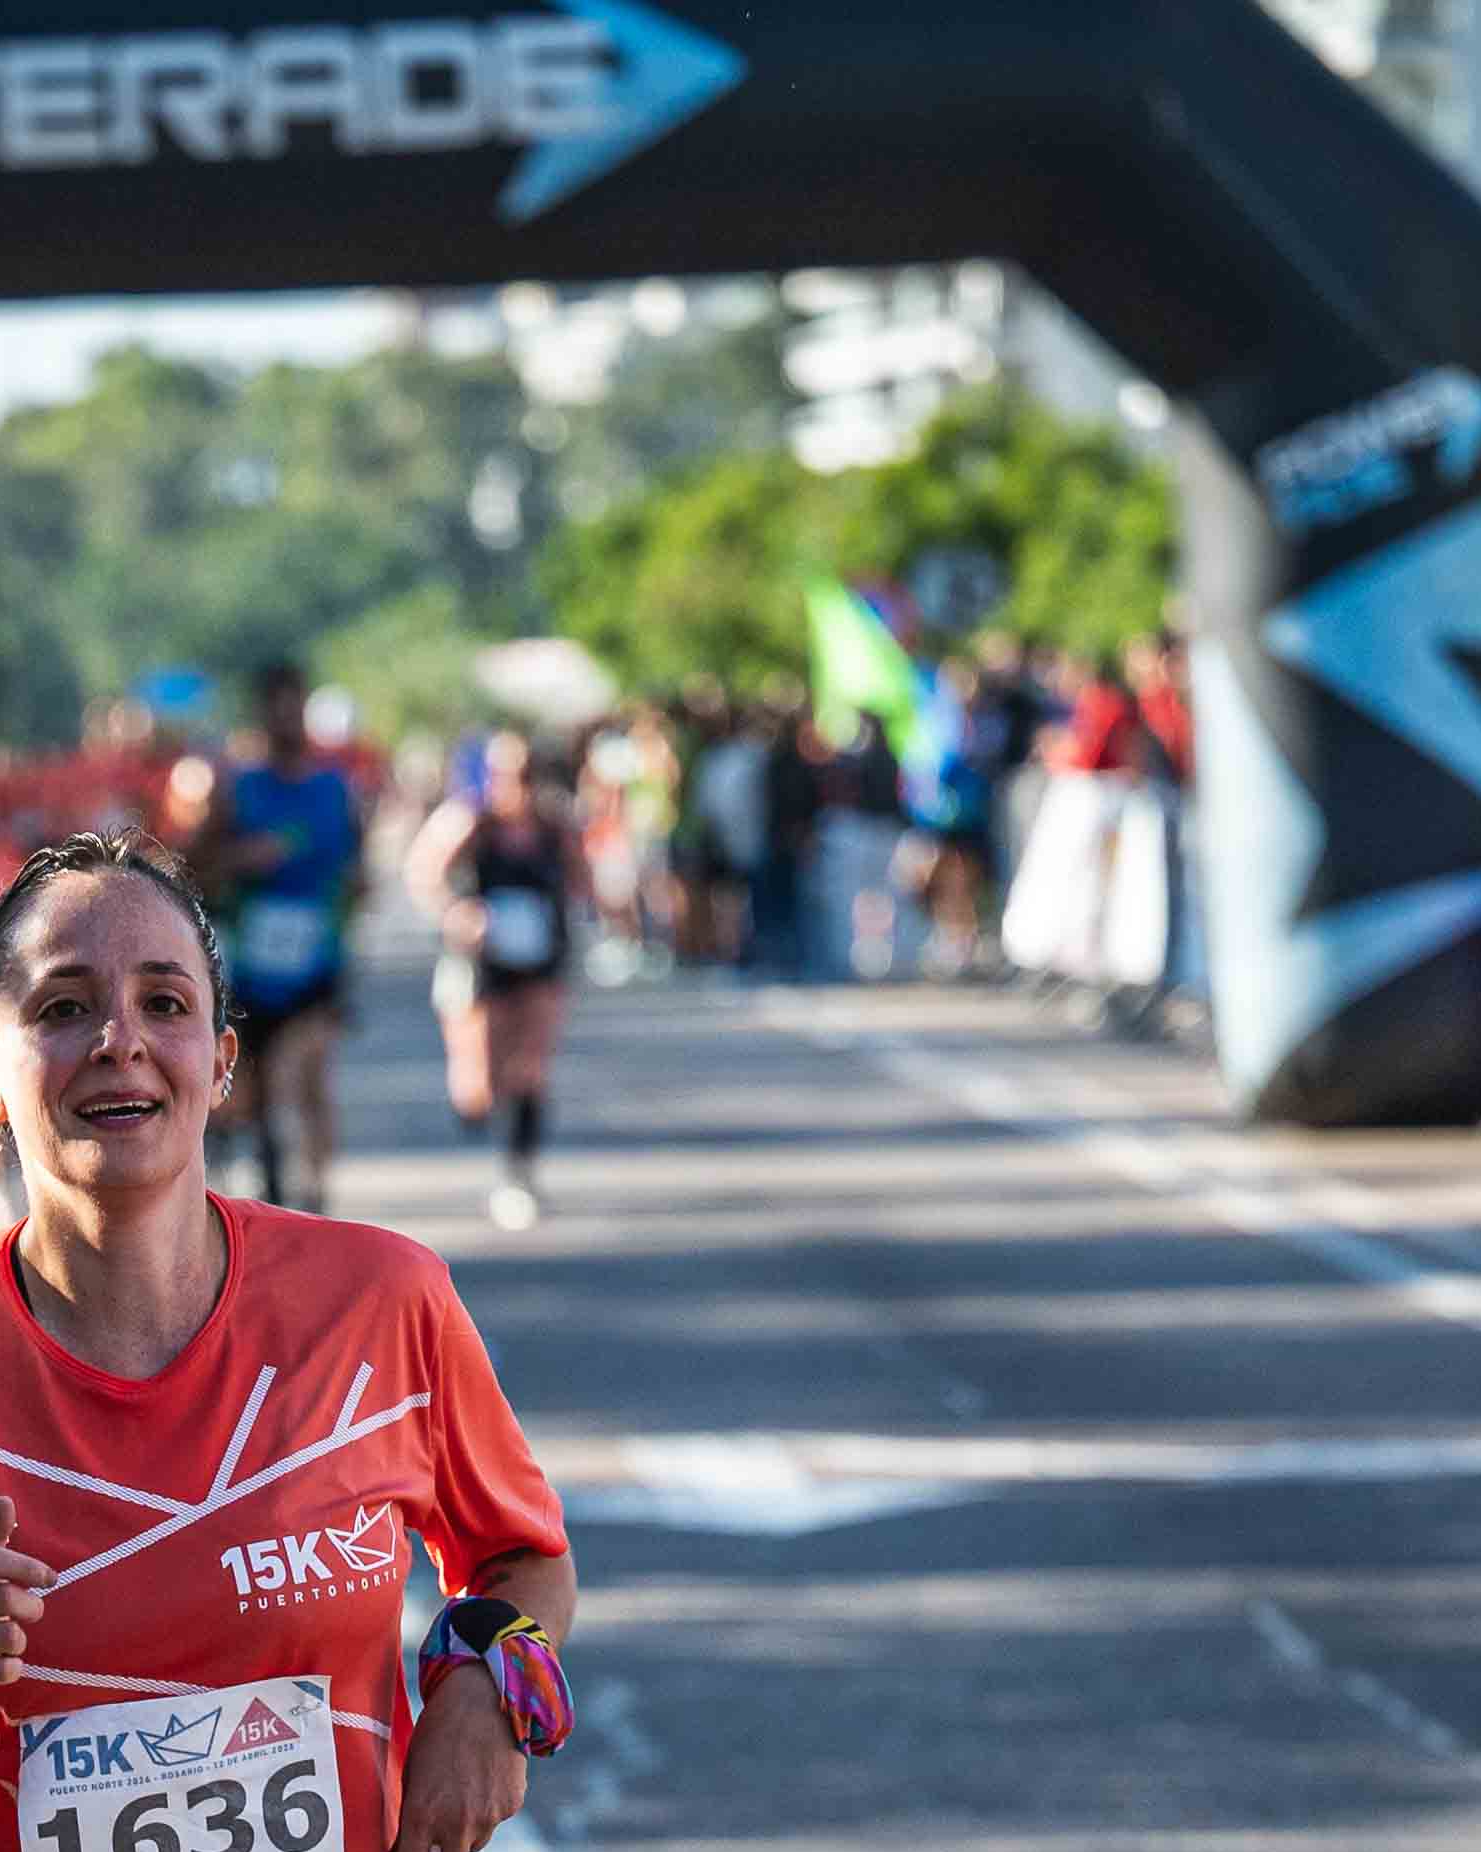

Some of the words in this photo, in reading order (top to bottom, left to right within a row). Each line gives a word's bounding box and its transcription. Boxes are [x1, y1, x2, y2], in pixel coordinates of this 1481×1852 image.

[220, 1531, 333, 1595] 15K
[238, 1585, 338, 1614] PUERTO
[238, 1717, 279, 1743] 15K
[46, 1732, 134, 1781] 15K
